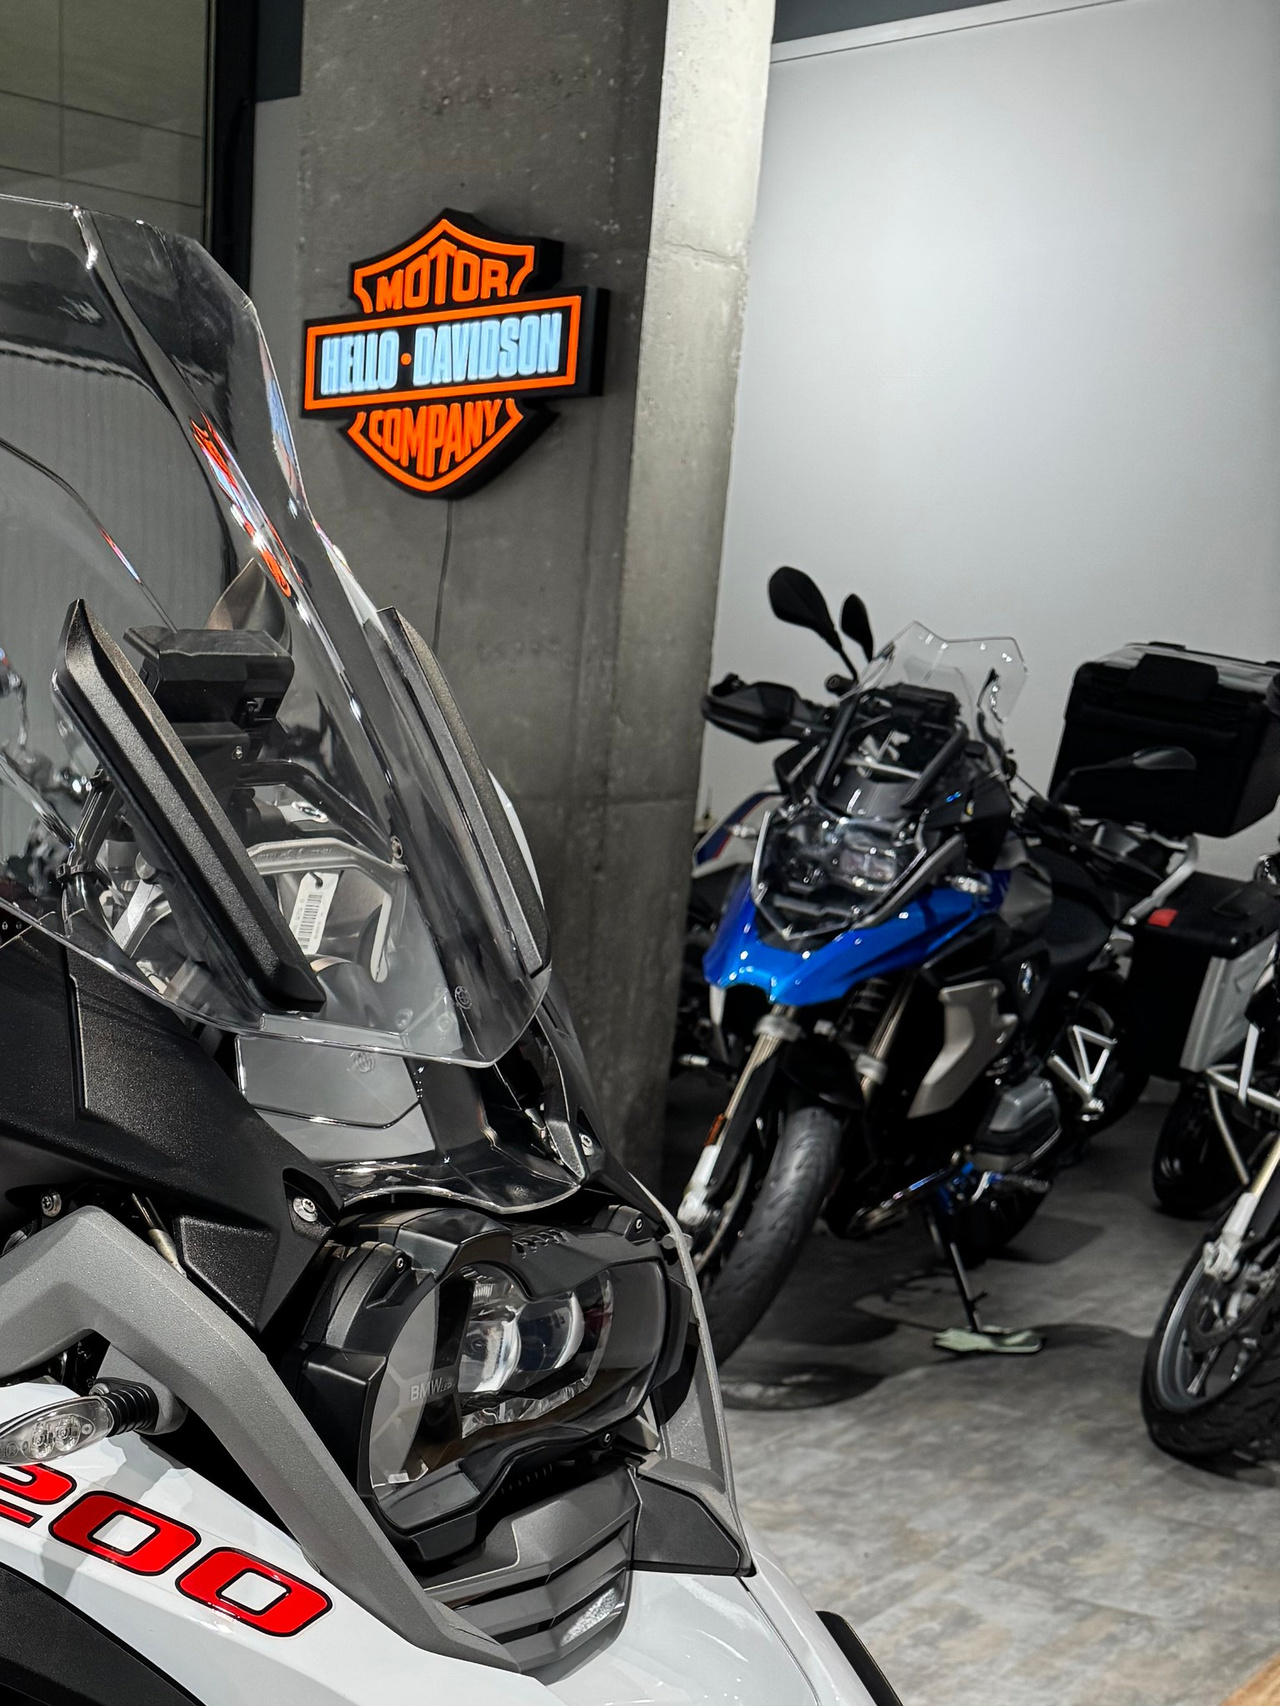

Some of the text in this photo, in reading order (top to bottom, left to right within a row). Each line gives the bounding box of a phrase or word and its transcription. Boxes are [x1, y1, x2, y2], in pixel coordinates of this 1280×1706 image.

[376, 238, 509, 312] MOTOR
[320, 312, 563, 395] HELLO DAVIDSON
[369, 399, 503, 478] COMPANY
[410, 1377, 442, 1401] BMW
